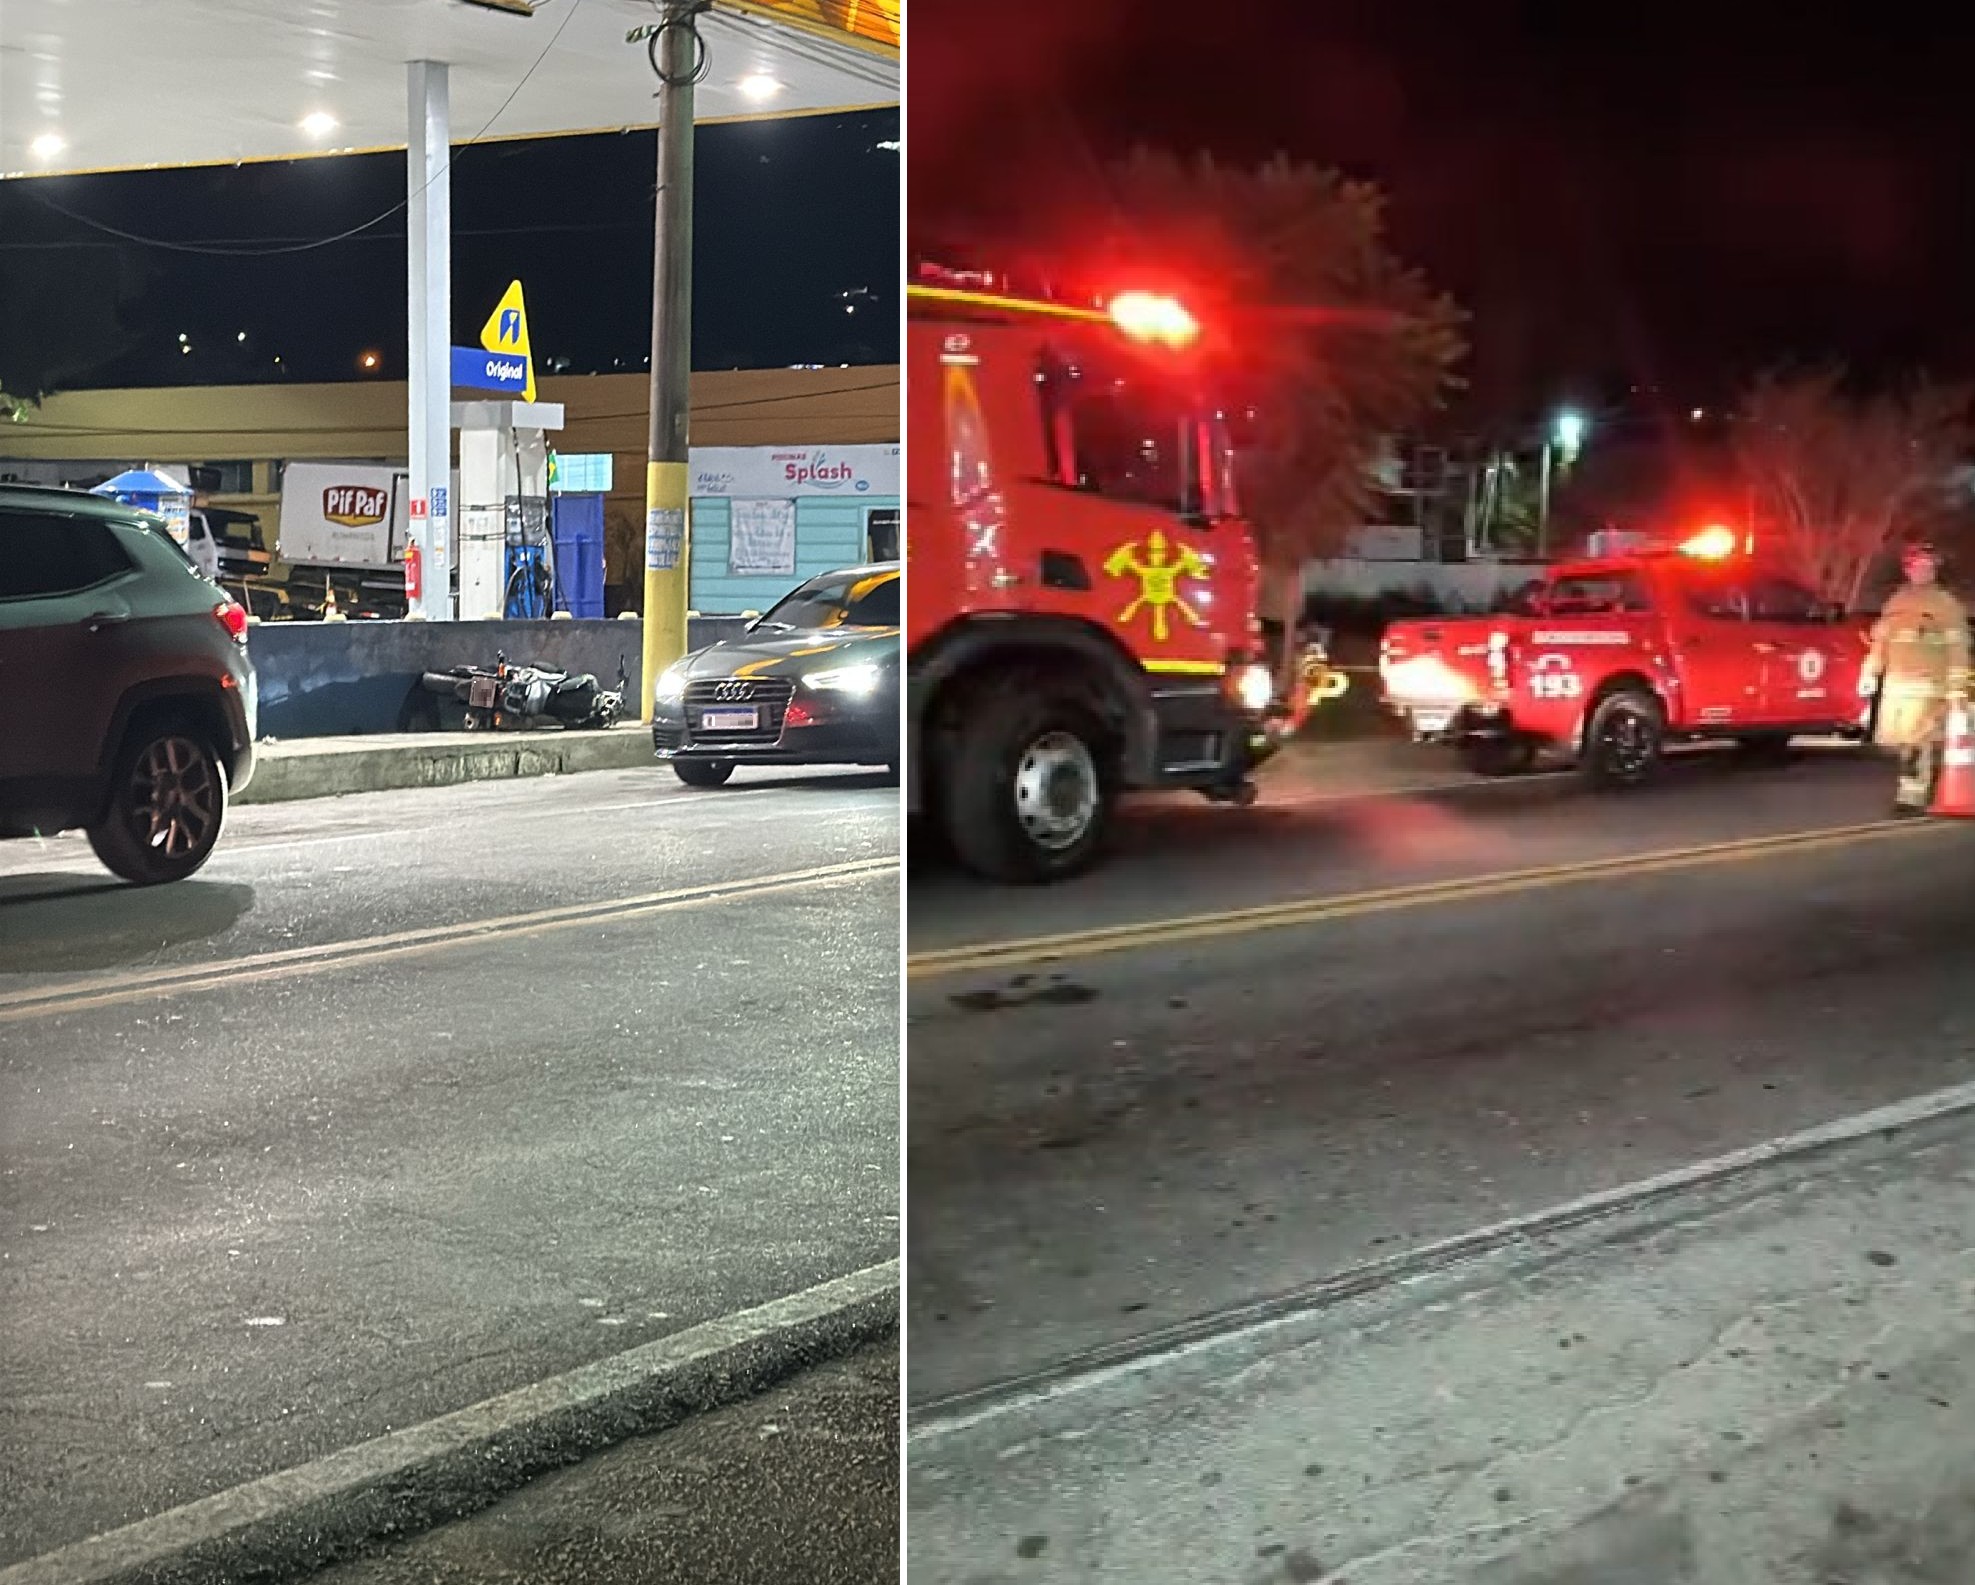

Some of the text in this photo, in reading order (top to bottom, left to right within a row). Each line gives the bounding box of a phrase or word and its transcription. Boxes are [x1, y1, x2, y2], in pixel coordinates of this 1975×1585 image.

[486, 360, 523, 381] Original
[785, 461, 852, 484] Splash
[327, 489, 385, 516] Pif Paf
